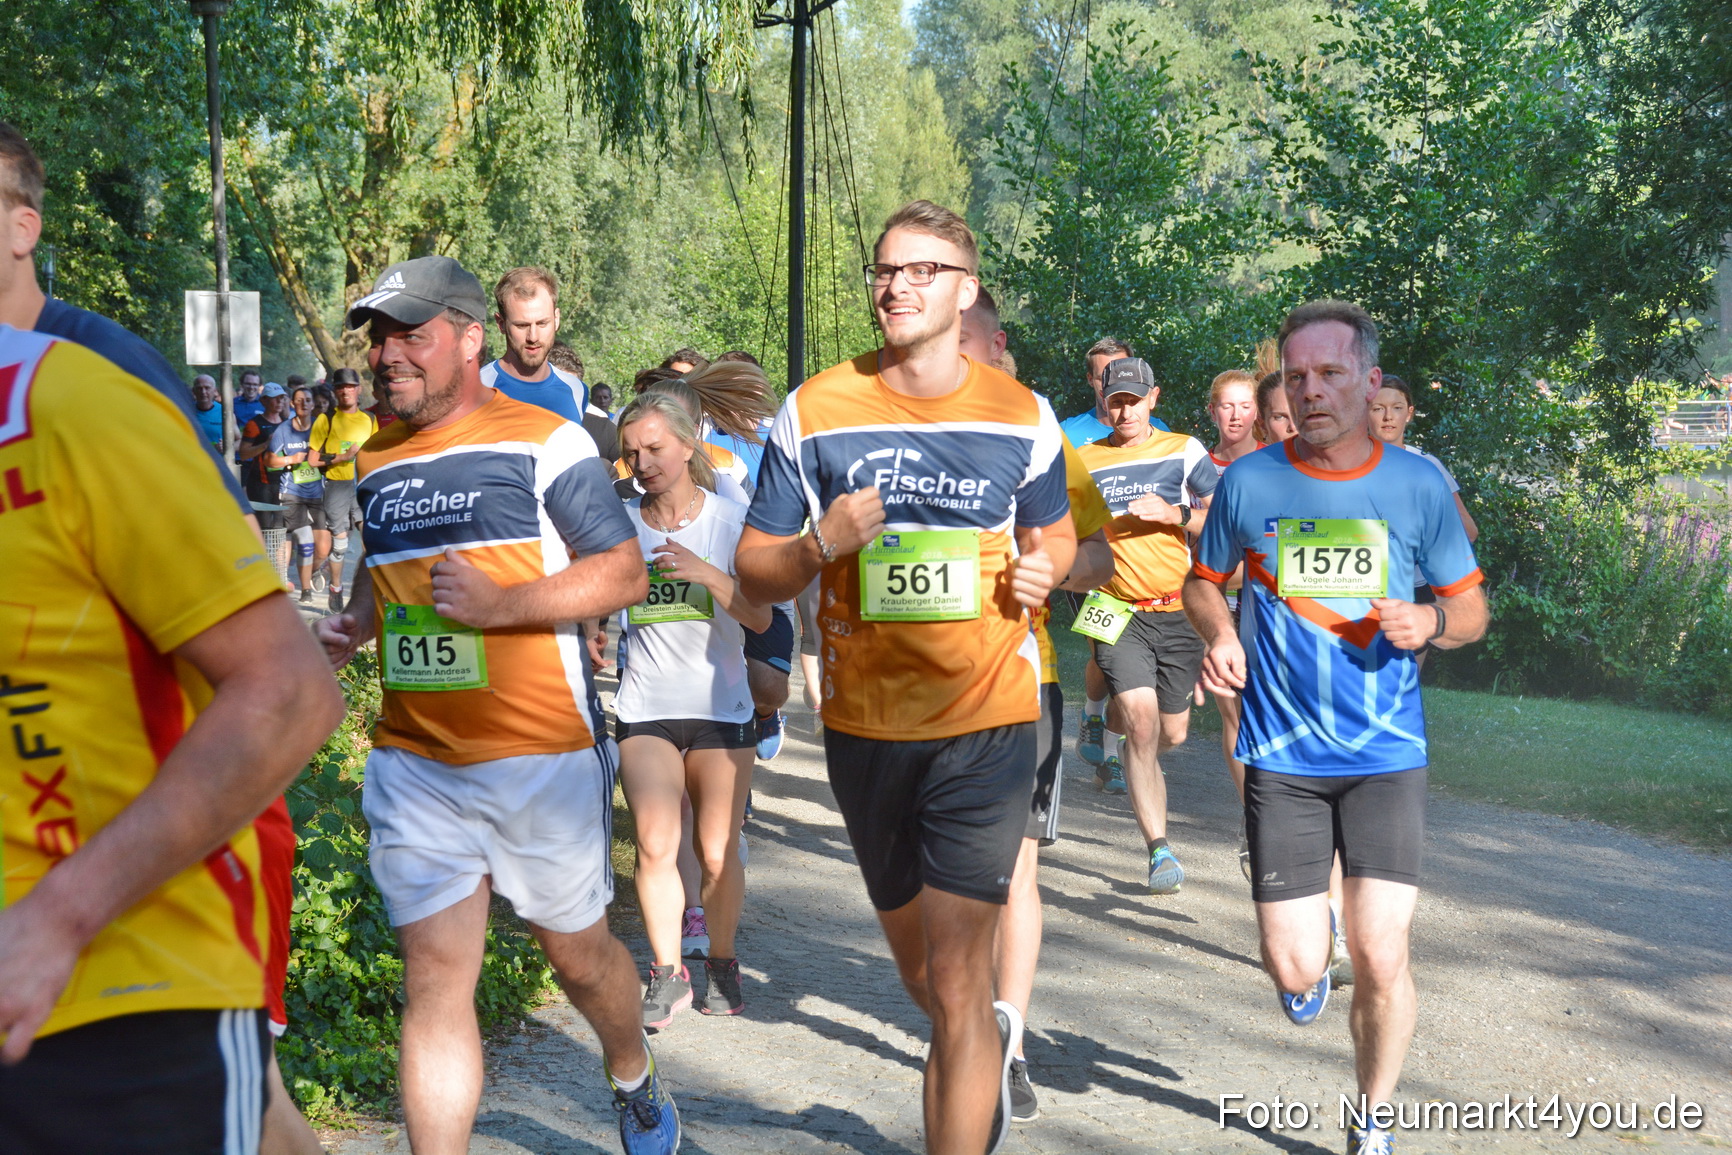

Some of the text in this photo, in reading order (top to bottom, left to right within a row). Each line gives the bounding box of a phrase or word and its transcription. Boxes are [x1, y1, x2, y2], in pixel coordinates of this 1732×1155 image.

[300, 468, 315, 477] 503
[874, 469, 990, 496] Fischer
[1103, 482, 1160, 498] Fischer
[380, 490, 481, 521] Fischer
[885, 494, 981, 510] AUTOMOBILE
[391, 512, 472, 533] AUTOMOBILE
[874, 546, 916, 554] firmenlauf
[1292, 547, 1372, 575] 1578
[887, 563, 948, 595] 561
[1302, 576, 1330, 584] Vögele
[646, 582, 691, 605] 697
[880, 596, 962, 606] Krauberger Daniel
[1084, 606, 1114, 628] 556
[398, 635, 456, 666] 615
[392, 667, 471, 676] Kellermann Andreas
